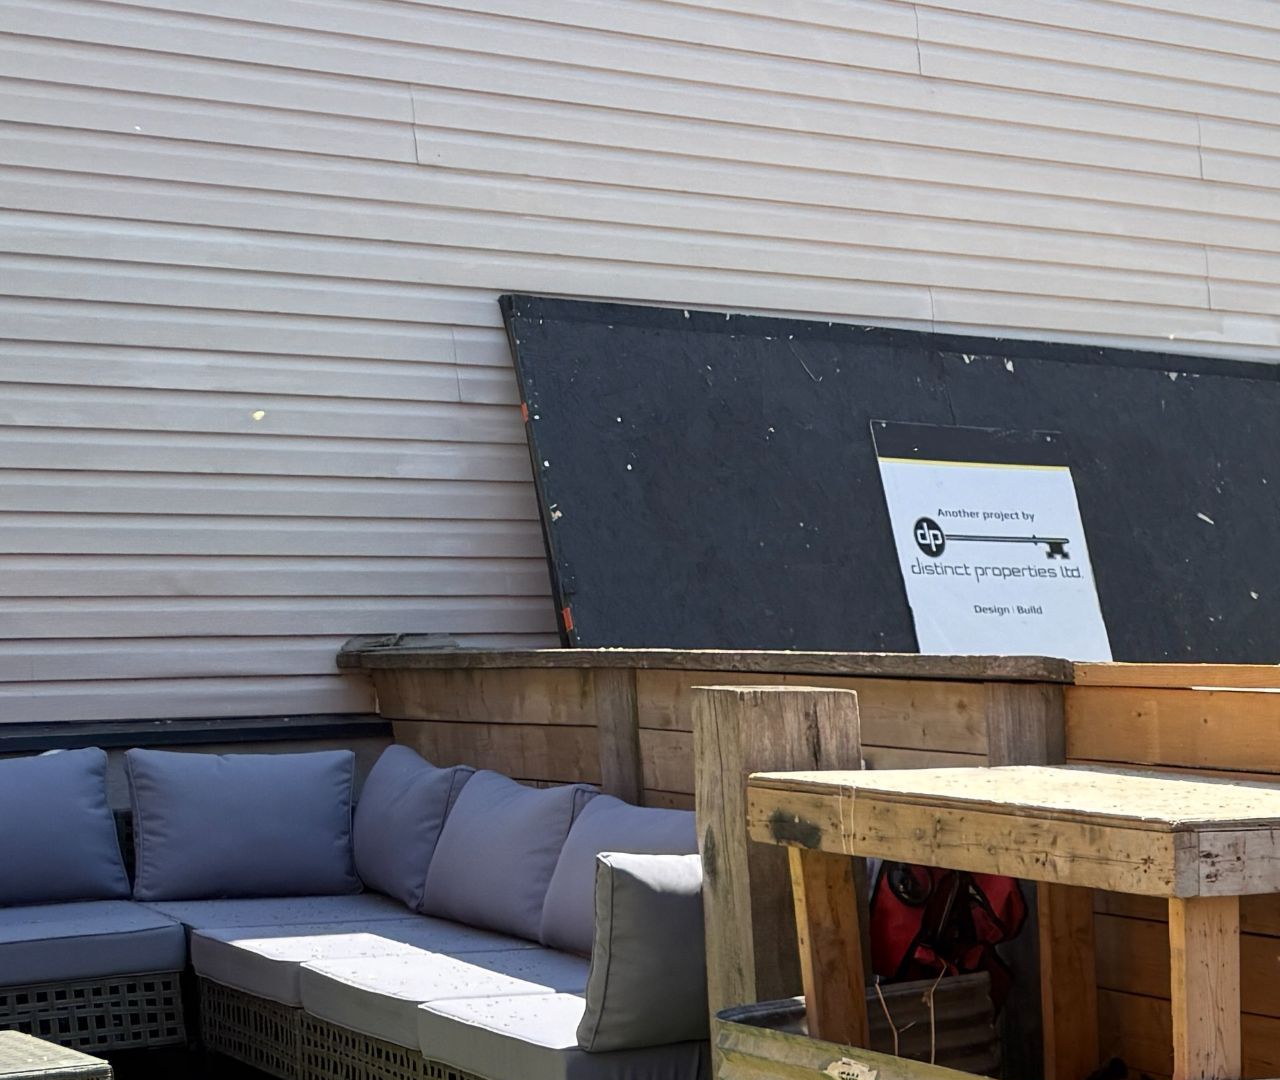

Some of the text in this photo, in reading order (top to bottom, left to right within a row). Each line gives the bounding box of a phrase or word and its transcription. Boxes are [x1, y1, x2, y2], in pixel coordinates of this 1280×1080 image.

[937, 508, 1036, 523] Another project by
[916, 521, 943, 552] dp
[911, 557, 971, 576] distinct
[975, 563, 1058, 583] properties
[973, 604, 1043, 616] Design Build
